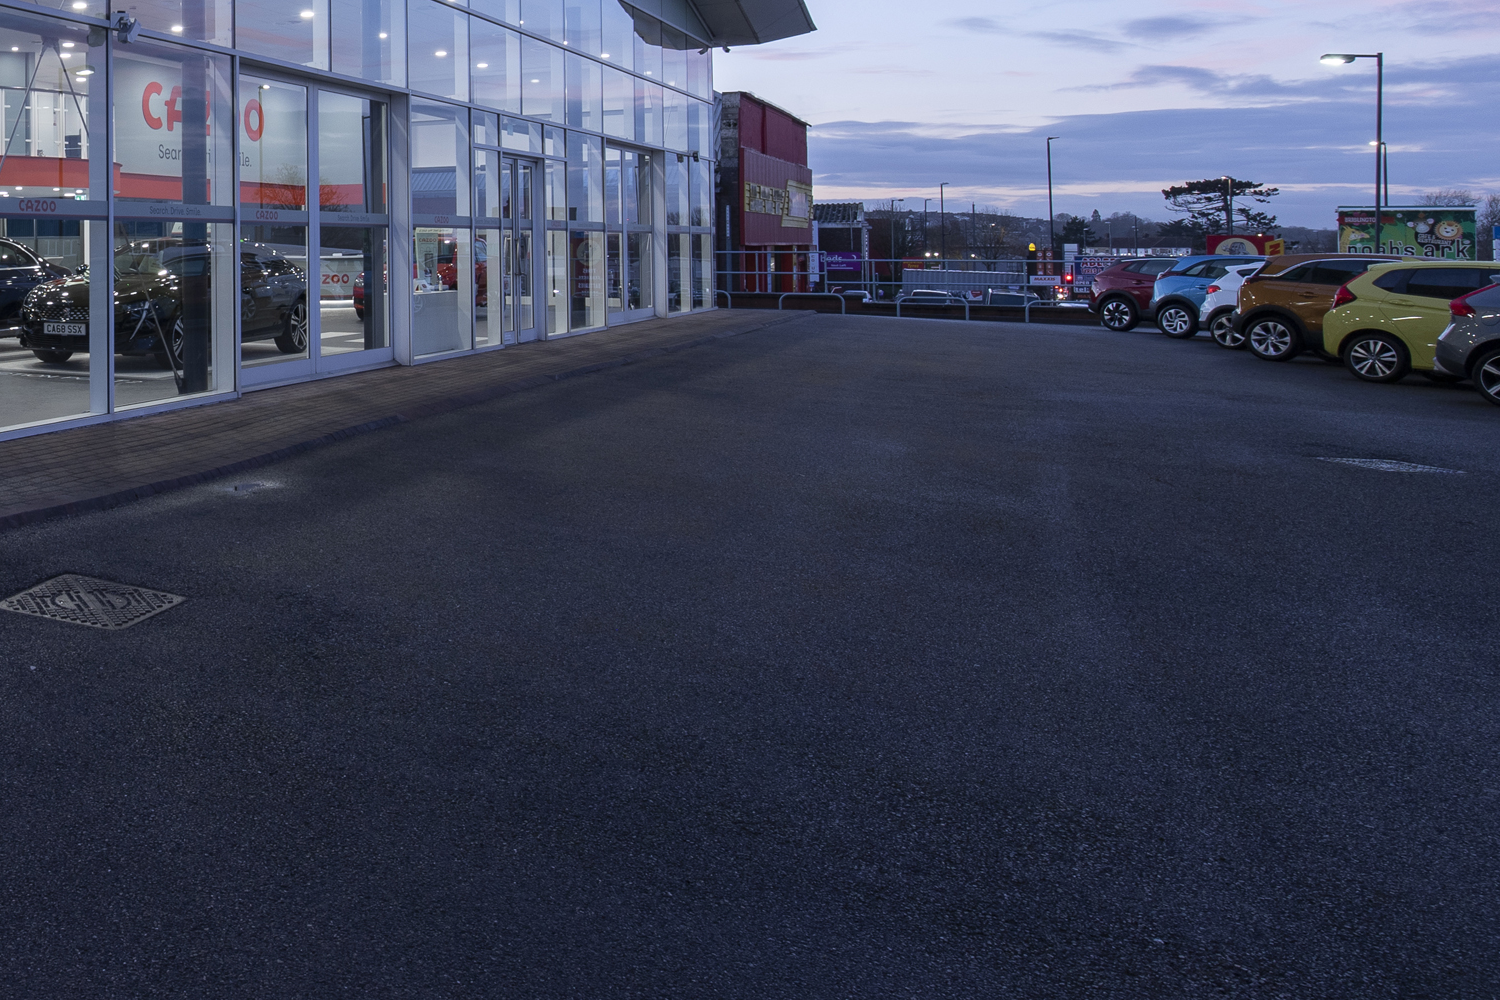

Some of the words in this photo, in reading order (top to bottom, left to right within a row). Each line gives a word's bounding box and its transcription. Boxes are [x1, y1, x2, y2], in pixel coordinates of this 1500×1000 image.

[19, 200, 56, 212] CAZOO
[150, 205, 169, 215] Search.
[255, 210, 279, 220] CAZOO
[1423, 239, 1471, 259] ark
[46, 324, 66, 333] CA68
[67, 325, 83, 334] SSX
